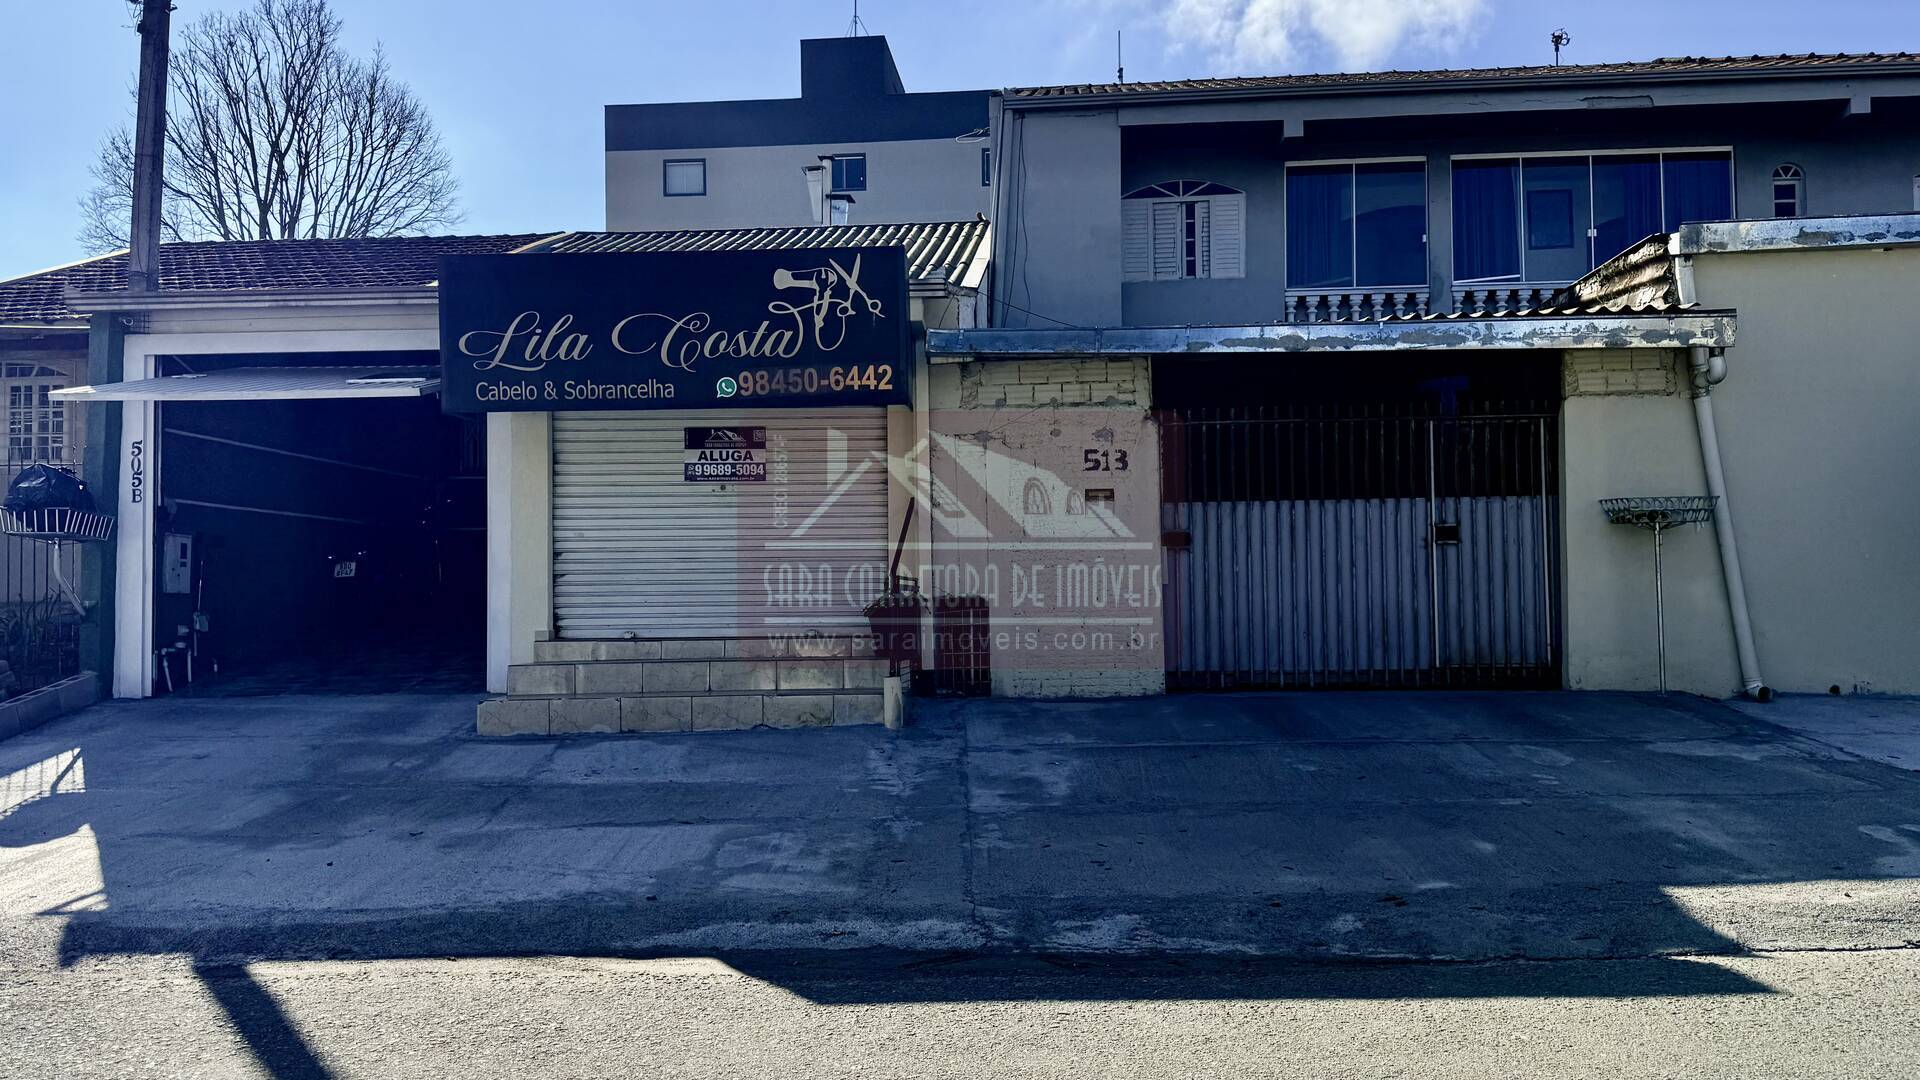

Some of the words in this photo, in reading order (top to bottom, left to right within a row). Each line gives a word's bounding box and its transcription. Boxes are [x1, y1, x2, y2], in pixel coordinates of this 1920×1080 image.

[458, 310, 593, 372] Lila
[611, 311, 796, 373] Costa
[475, 380, 538, 401] Cabelo
[544, 380, 559, 400] &
[563, 378, 675, 400] Sobrancelha
[738, 363, 894, 396] 98450-6442
[697, 450, 754, 462] ALUGA
[1082, 448, 1129, 472] 513
[130, 439, 143, 504] 505B
